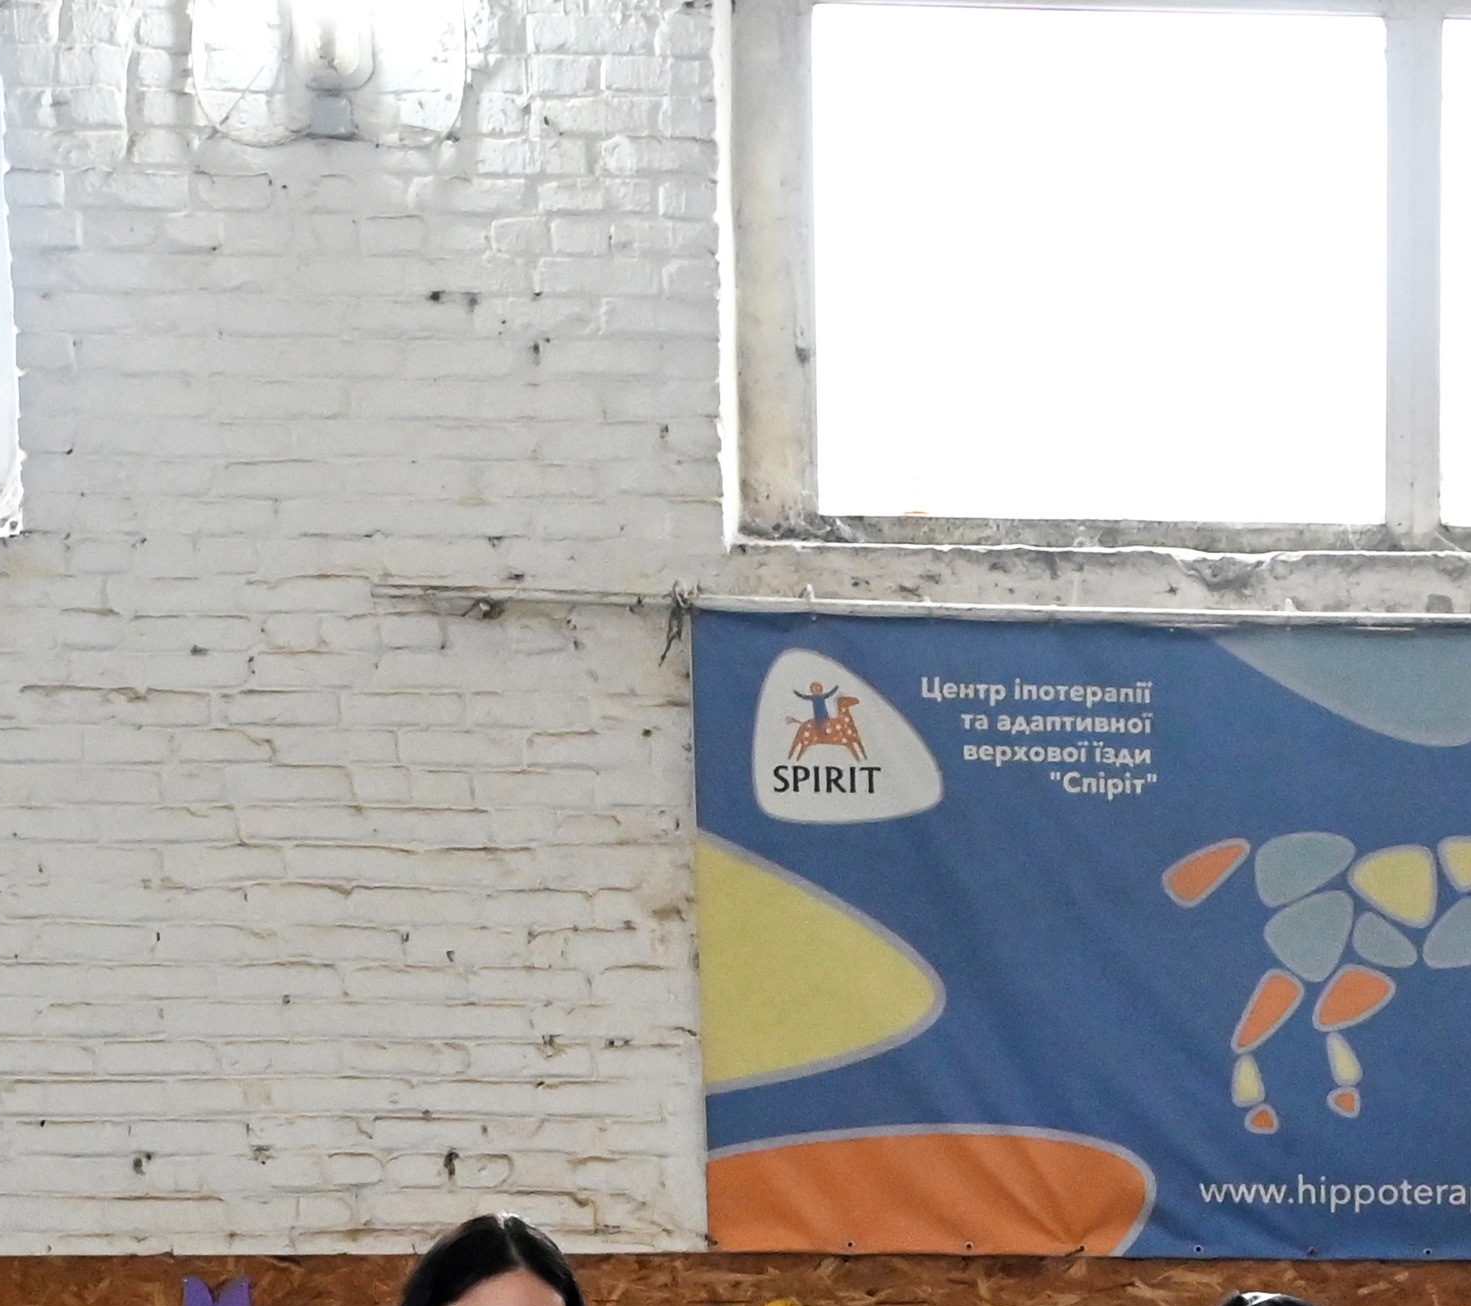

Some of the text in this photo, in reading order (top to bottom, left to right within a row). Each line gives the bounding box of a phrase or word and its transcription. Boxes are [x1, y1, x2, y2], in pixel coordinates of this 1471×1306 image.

[921, 676, 1153, 709] Центр іпотерапії
[961, 712, 1153, 735] та адаптивної
[963, 741, 1152, 767] верхової їзди
[773, 765, 882, 794] SPIRIT
[1050, 771, 1158, 800] "Спіріт"
